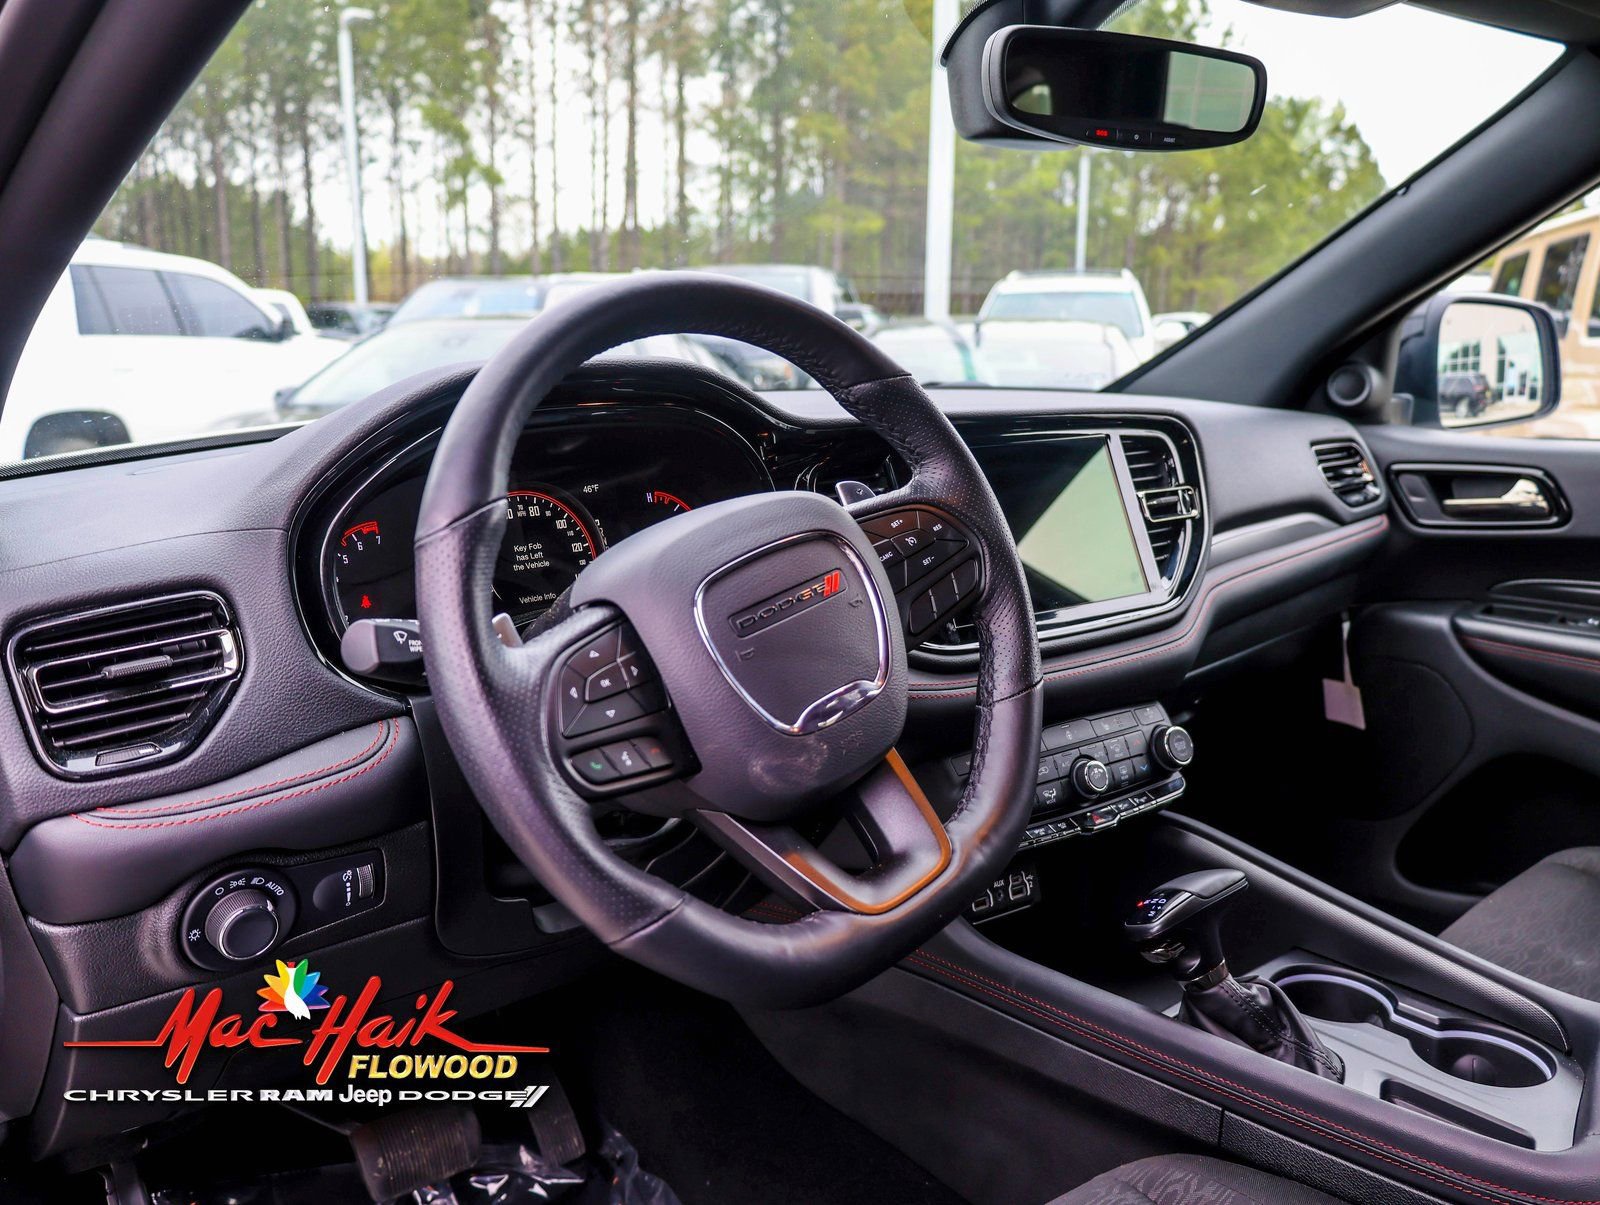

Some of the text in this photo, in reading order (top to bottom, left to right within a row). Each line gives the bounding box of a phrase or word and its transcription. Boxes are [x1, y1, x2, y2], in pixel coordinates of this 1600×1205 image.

[583, 484, 599, 493] 46°F
[646, 492, 653, 503] H
[528, 505, 540, 517] 80
[555, 519, 568, 530] 100
[376, 535, 381, 545] 7
[357, 541, 363, 551] 6
[513, 542, 543, 553] Key Fob
[572, 542, 583, 553] 120
[342, 554, 349, 564] 5
[516, 551, 544, 561] has Left
[513, 560, 550, 572] the Vehicle
[519, 592, 557, 604] Vehicle Info
[735, 581, 826, 630] DODGE
[265, 881, 285, 897] AUTO
[993, 879, 1005, 889] AUX
